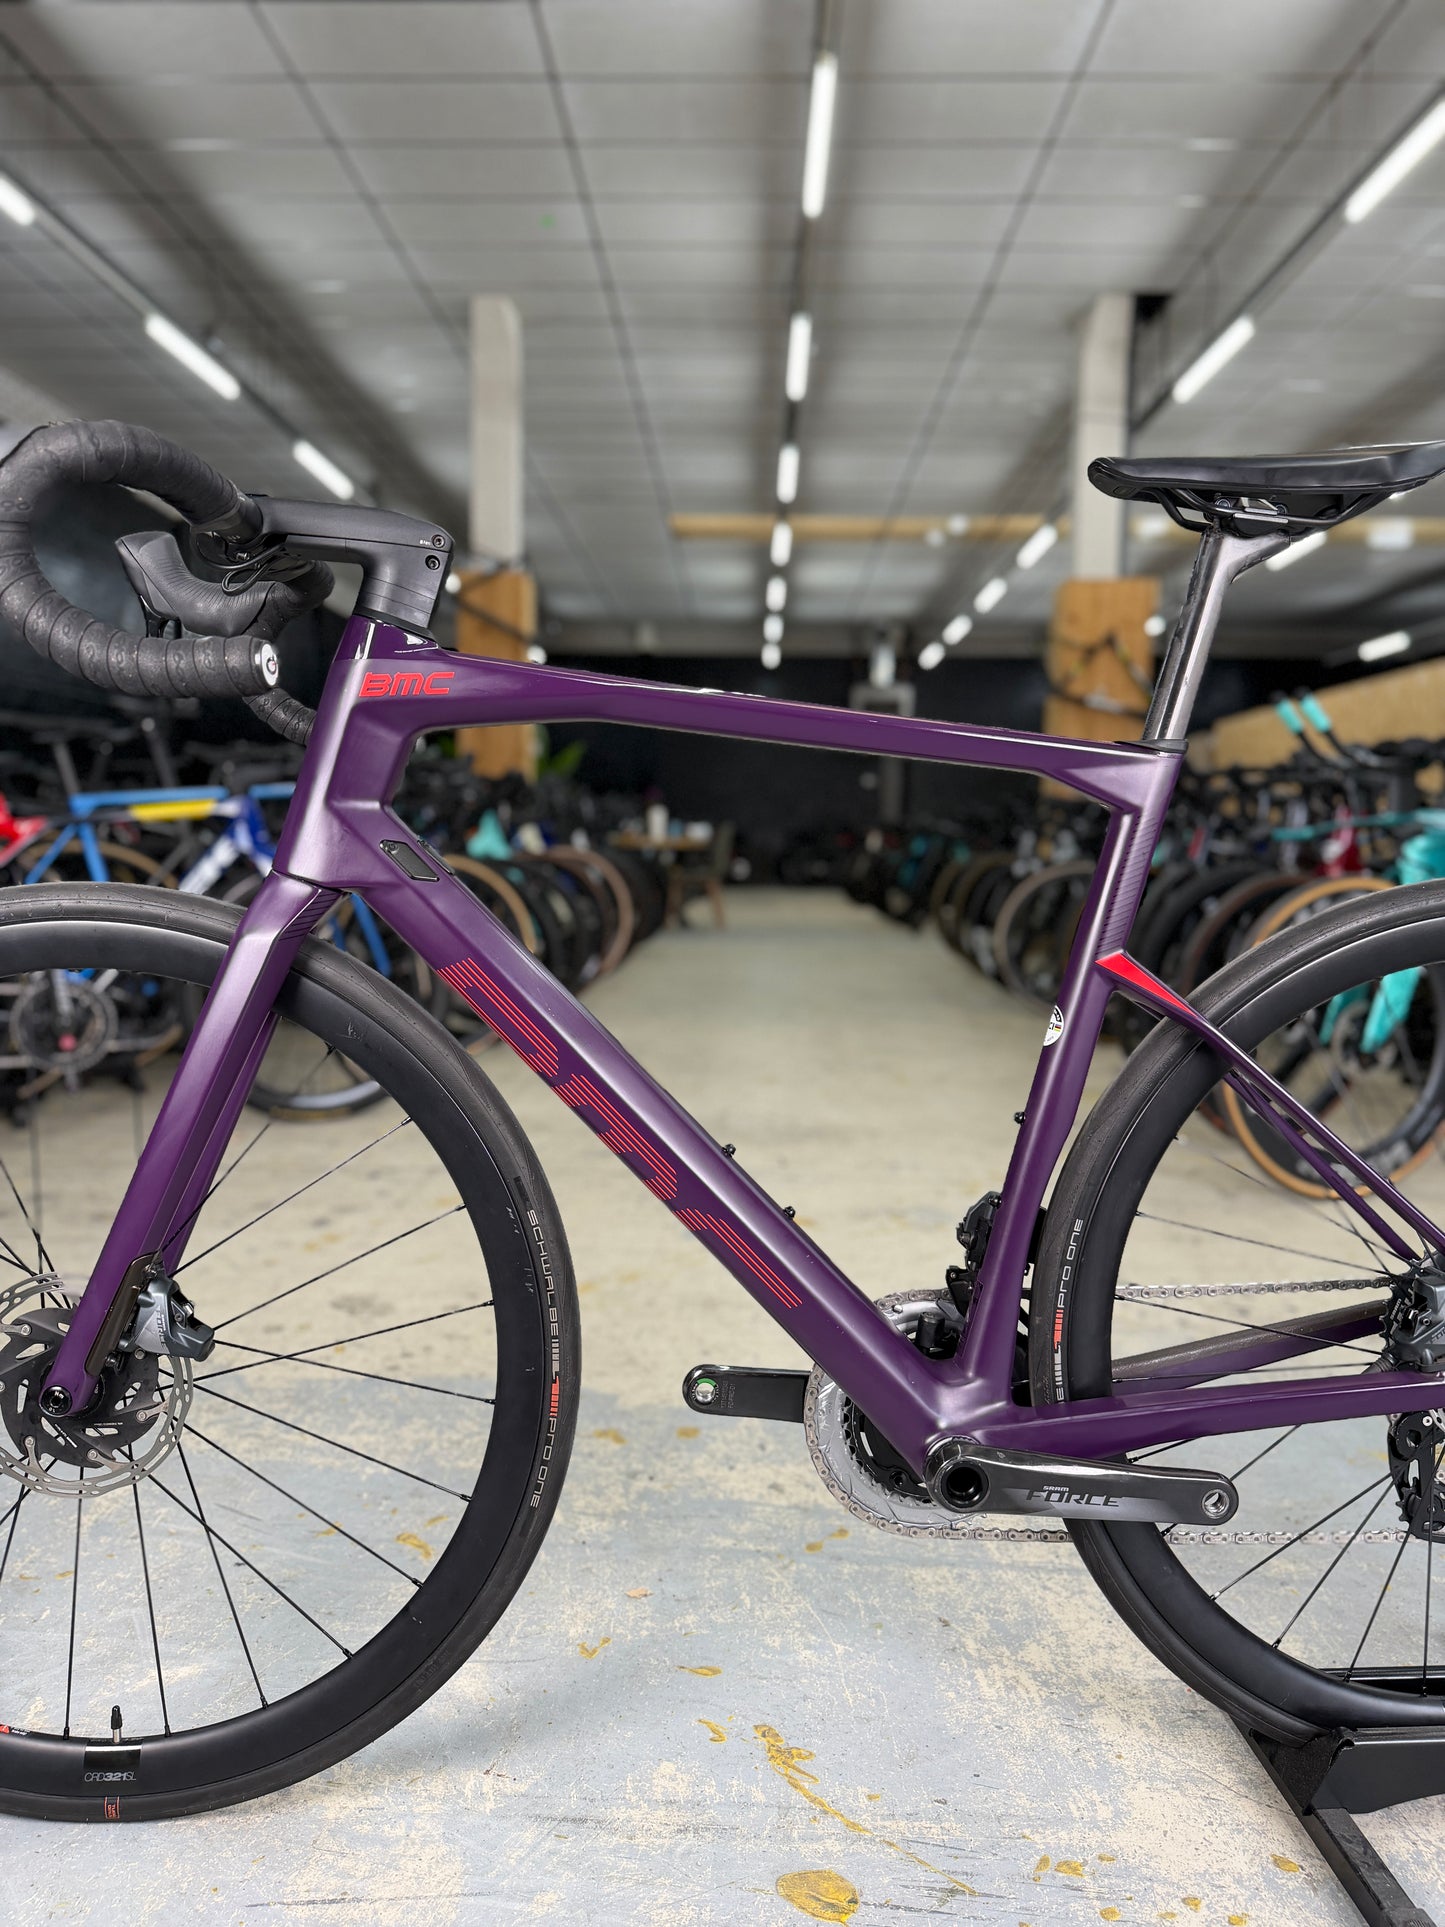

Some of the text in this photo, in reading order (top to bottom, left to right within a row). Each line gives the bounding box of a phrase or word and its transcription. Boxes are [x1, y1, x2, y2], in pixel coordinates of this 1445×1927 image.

[359, 671, 455, 698] BMC
[526, 1209, 559, 1337] SCHWALBE
[1026, 1490, 1119, 1507] FORCE
